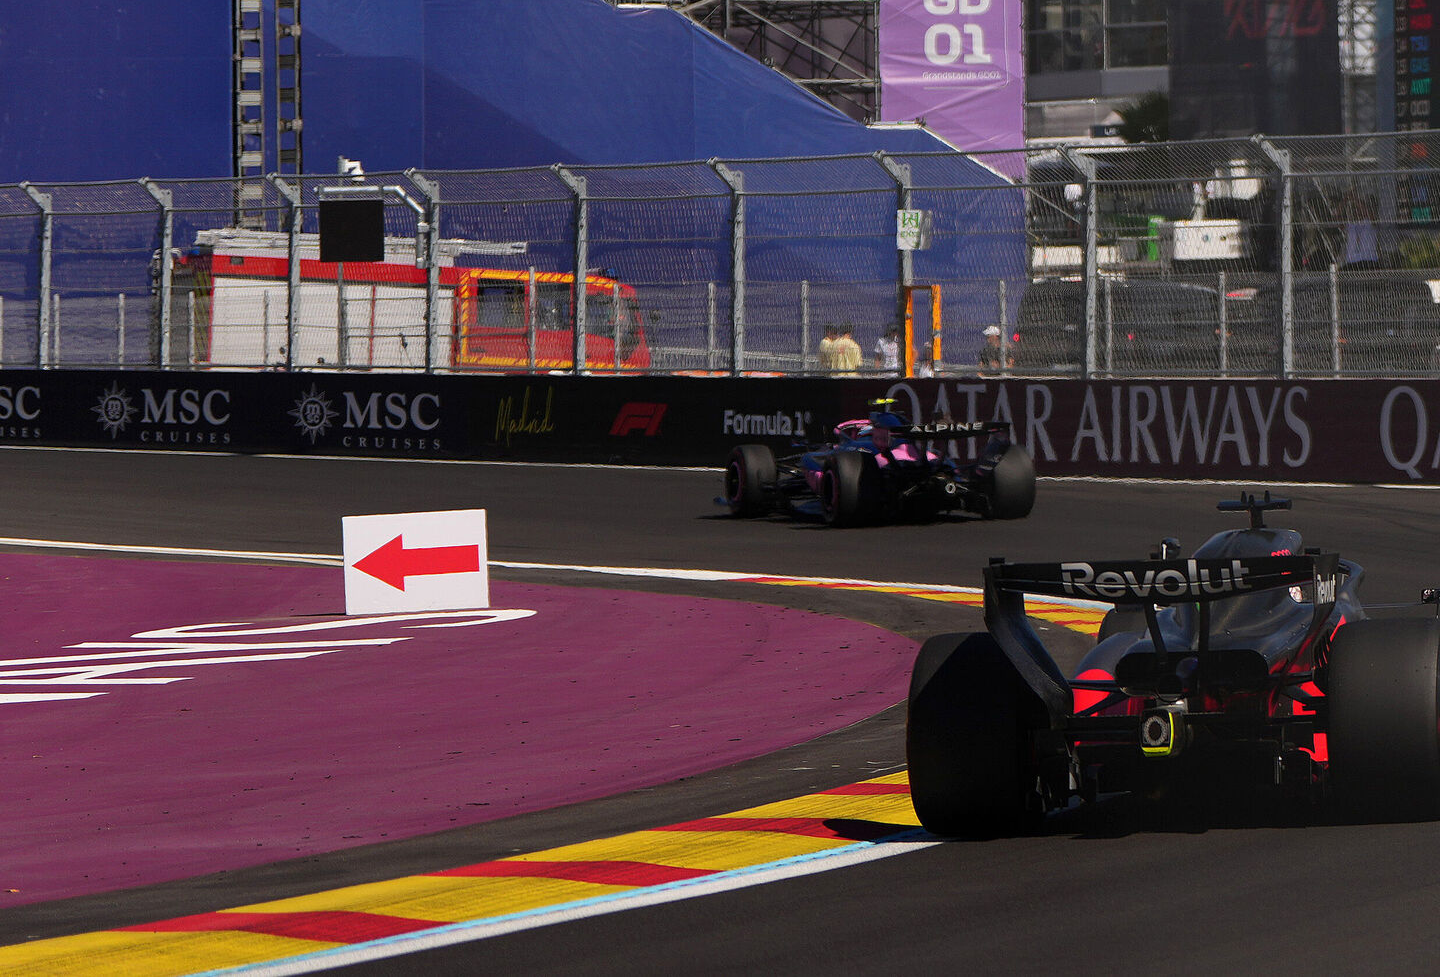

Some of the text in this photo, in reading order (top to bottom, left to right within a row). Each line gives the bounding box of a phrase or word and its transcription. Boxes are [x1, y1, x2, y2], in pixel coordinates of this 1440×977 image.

[923, 23, 992, 65] 01
[141, 389, 231, 423] MSC
[343, 391, 441, 431] MSC
[494, 385, 554, 446] Madrid
[723, 409, 792, 436] Formula
[141, 430, 231, 443] CRUISES
[343, 436, 441, 450] CRUISES
[910, 422, 984, 434] ALPINE
[1071, 385, 1310, 469] AIRWAYS
[1061, 559, 1252, 599] Revolut
